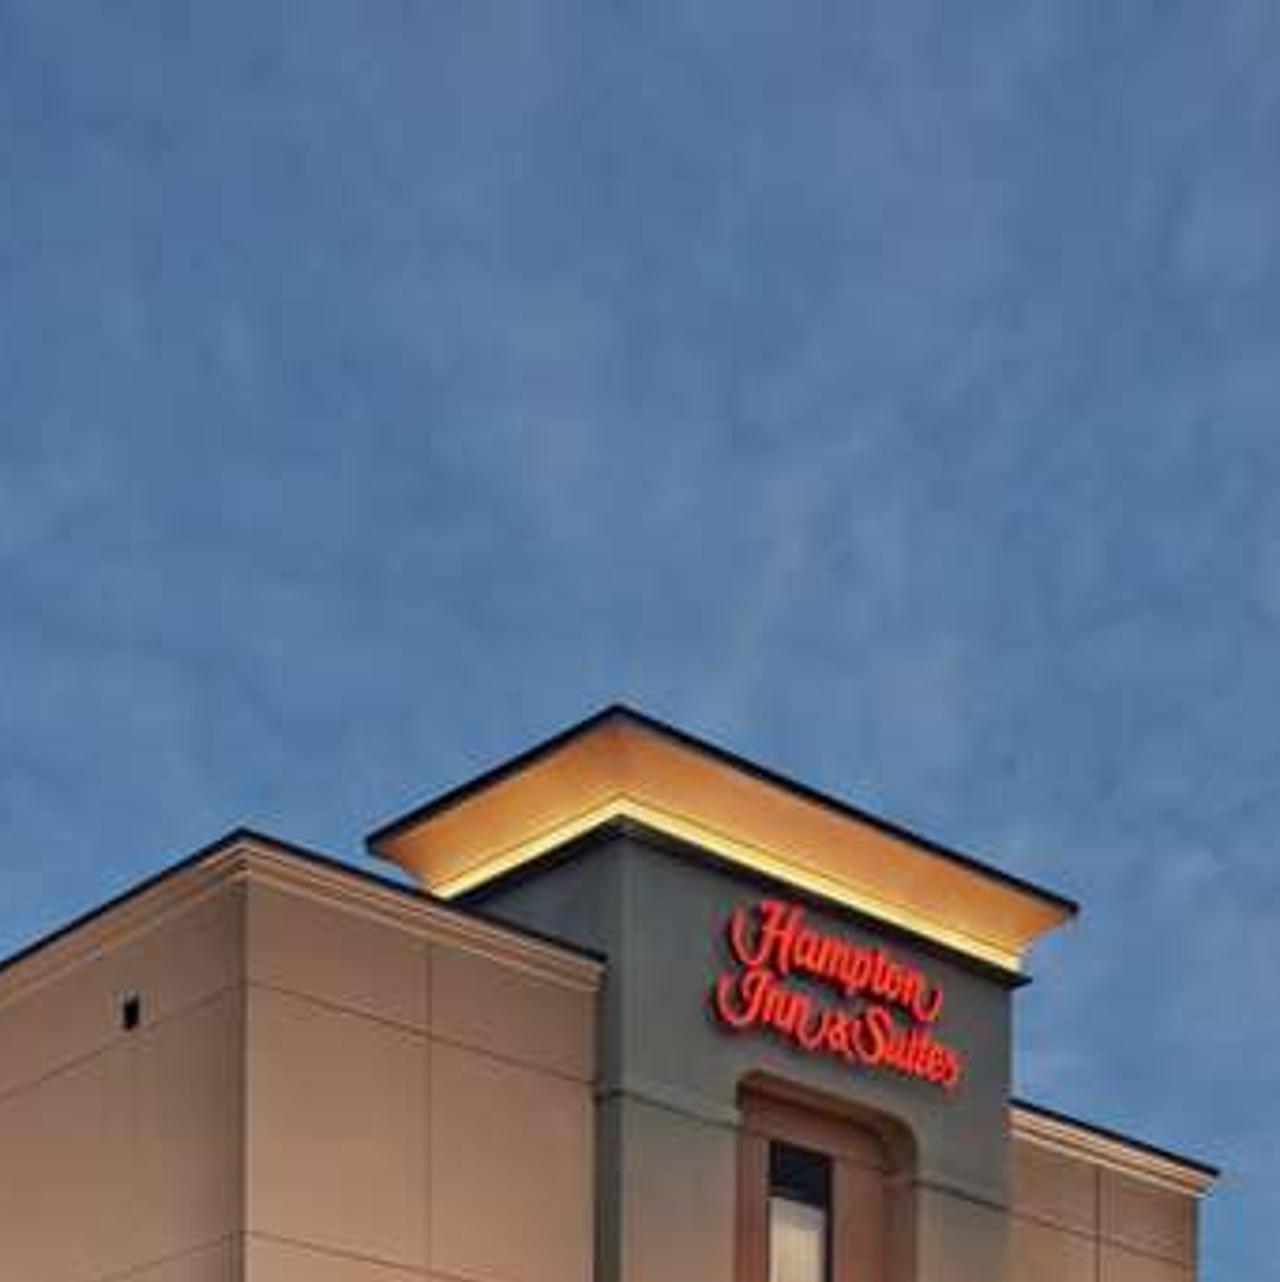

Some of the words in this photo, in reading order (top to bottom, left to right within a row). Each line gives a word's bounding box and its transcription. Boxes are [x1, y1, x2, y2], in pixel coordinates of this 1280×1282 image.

[730, 898, 944, 1022] Hampton
[717, 965, 823, 1049] Inn
[851, 1003, 960, 1084] Suites
